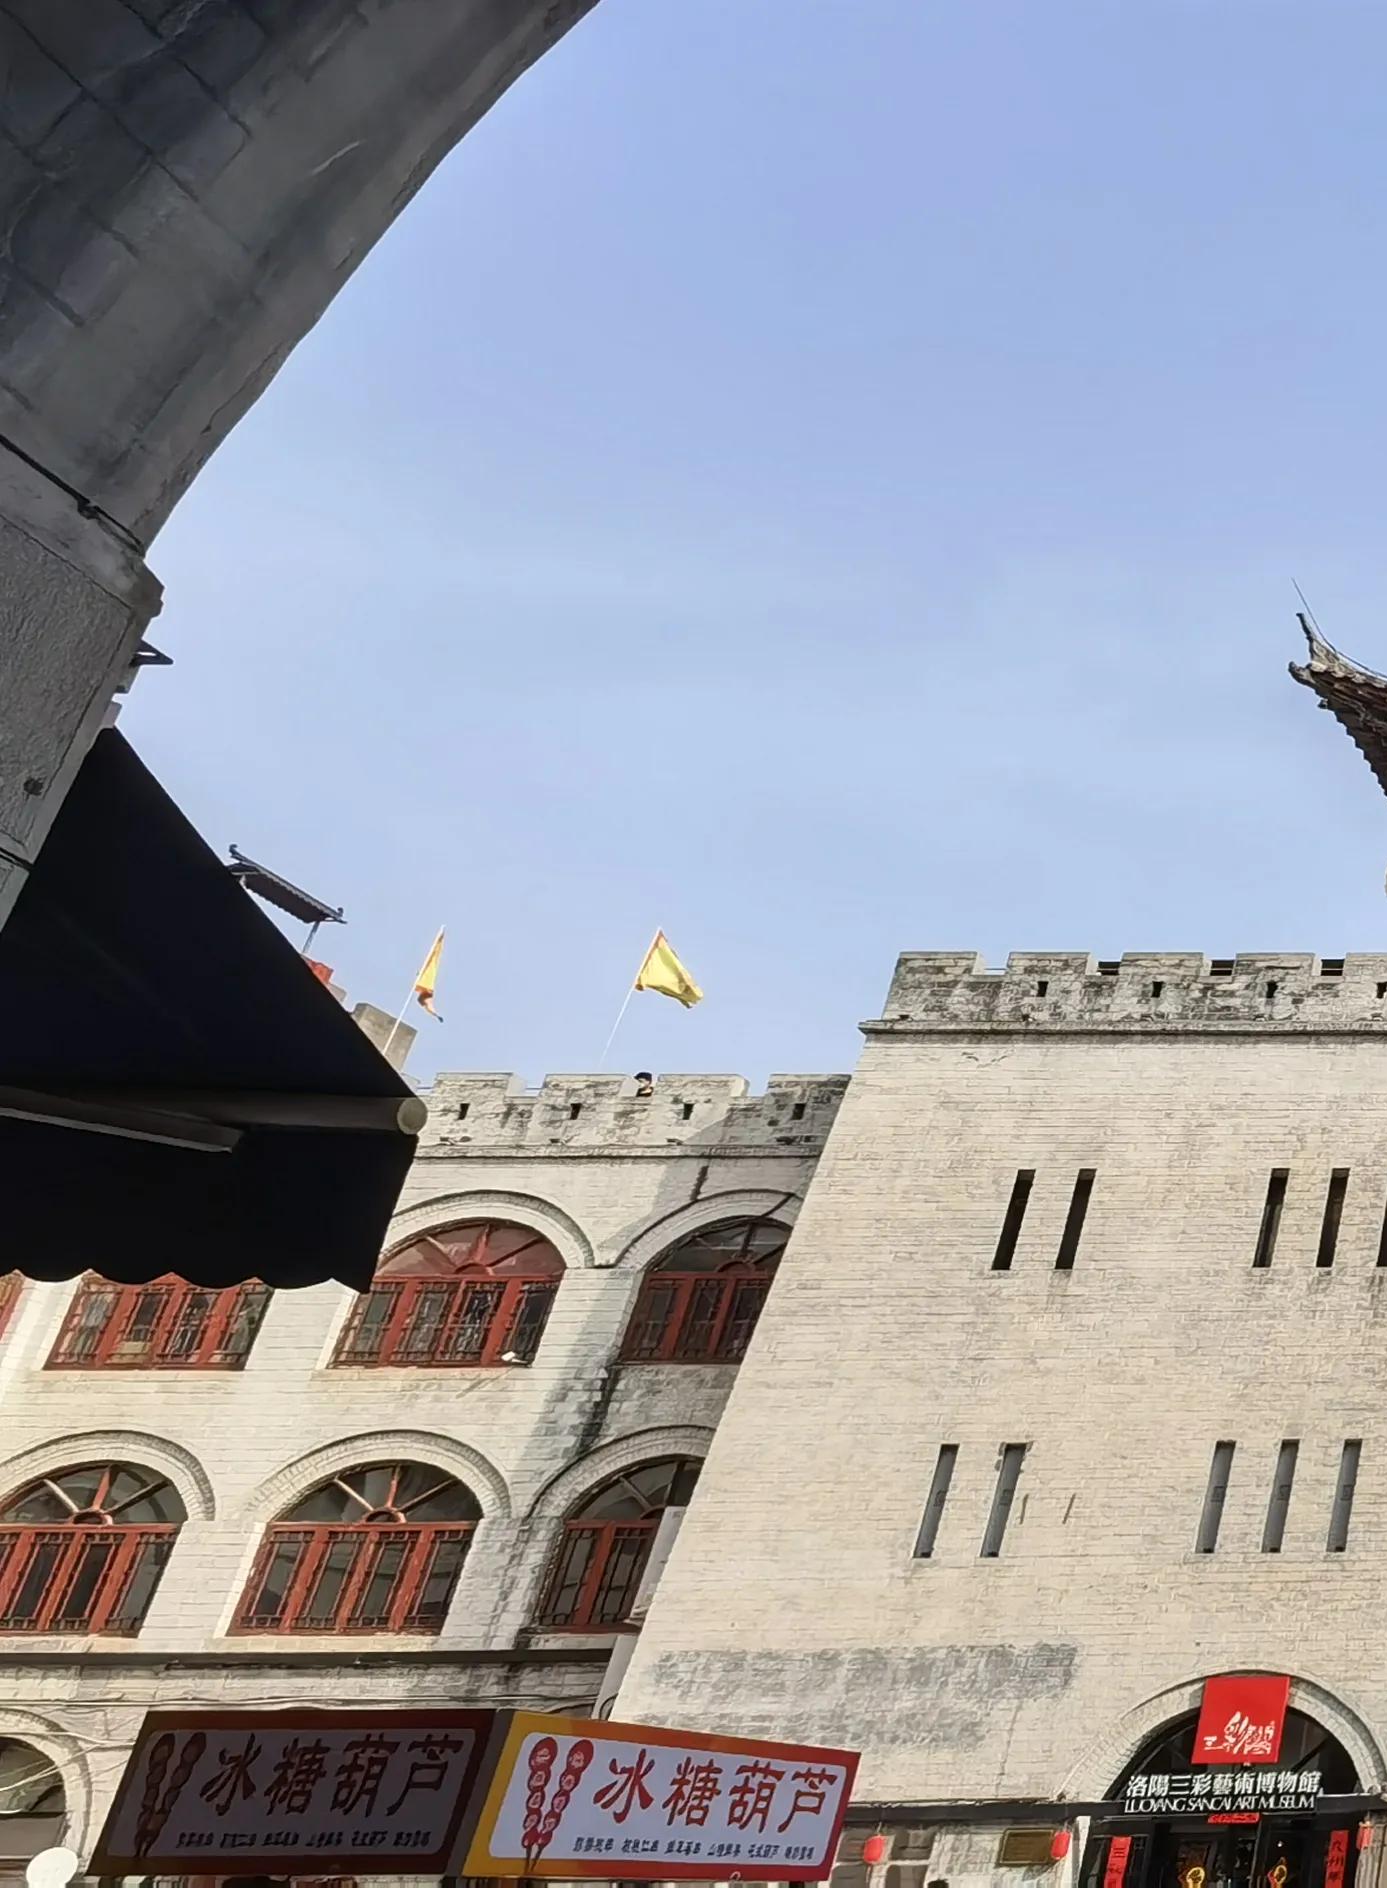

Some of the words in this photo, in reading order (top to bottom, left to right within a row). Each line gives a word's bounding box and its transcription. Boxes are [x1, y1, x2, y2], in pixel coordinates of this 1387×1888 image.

[200, 1733, 464, 1816] 冰糖葫芦
[593, 1748, 838, 1834] 冰糖葫芦
[1126, 1771, 1322, 1798] 洛陽三彩藝術博物館
[1124, 1798, 1187, 1814] LUOYANG
[1187, 1797, 1231, 1812] SANCAI
[1233, 1796, 1258, 1811] ART
[1259, 1795, 1315, 1810] MUSEUM
